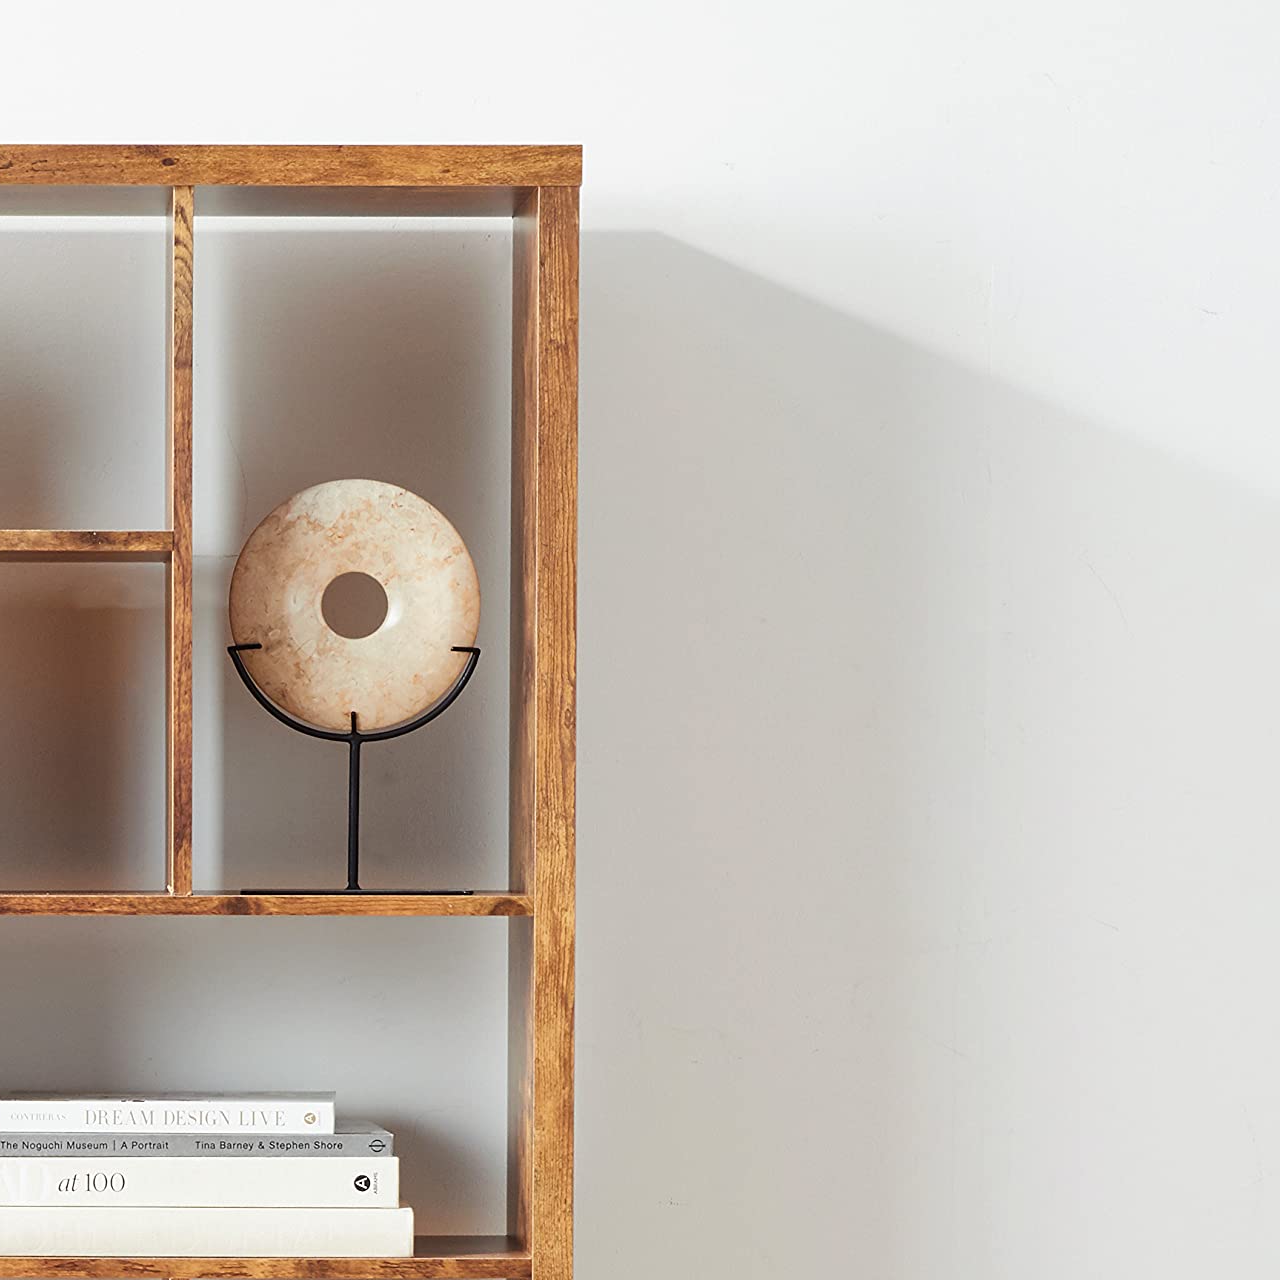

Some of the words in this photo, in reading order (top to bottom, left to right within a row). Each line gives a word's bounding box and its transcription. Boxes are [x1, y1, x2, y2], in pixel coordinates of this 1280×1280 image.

[10, 1112, 67, 1121] CONTRERAS
[85, 1110, 155, 1126] DREAM
[163, 1110, 231, 1127] DESIGN
[239, 1111, 286, 1127] LIVE
[0, 1141, 18, 1150] The
[22, 1141, 63, 1151] Noguchi
[66, 1141, 108, 1150] Museum
[120, 1141, 128, 1150] A
[132, 1141, 169, 1150] Portrait
[195, 1141, 216, 1150] Tina
[220, 1141, 254, 1151] Barney
[258, 1141, 265, 1150] &
[269, 1141, 310, 1151] Stephen
[314, 1141, 343, 1150] Shore
[58, 1172, 81, 1192] at
[86, 1172, 126, 1192] 100
